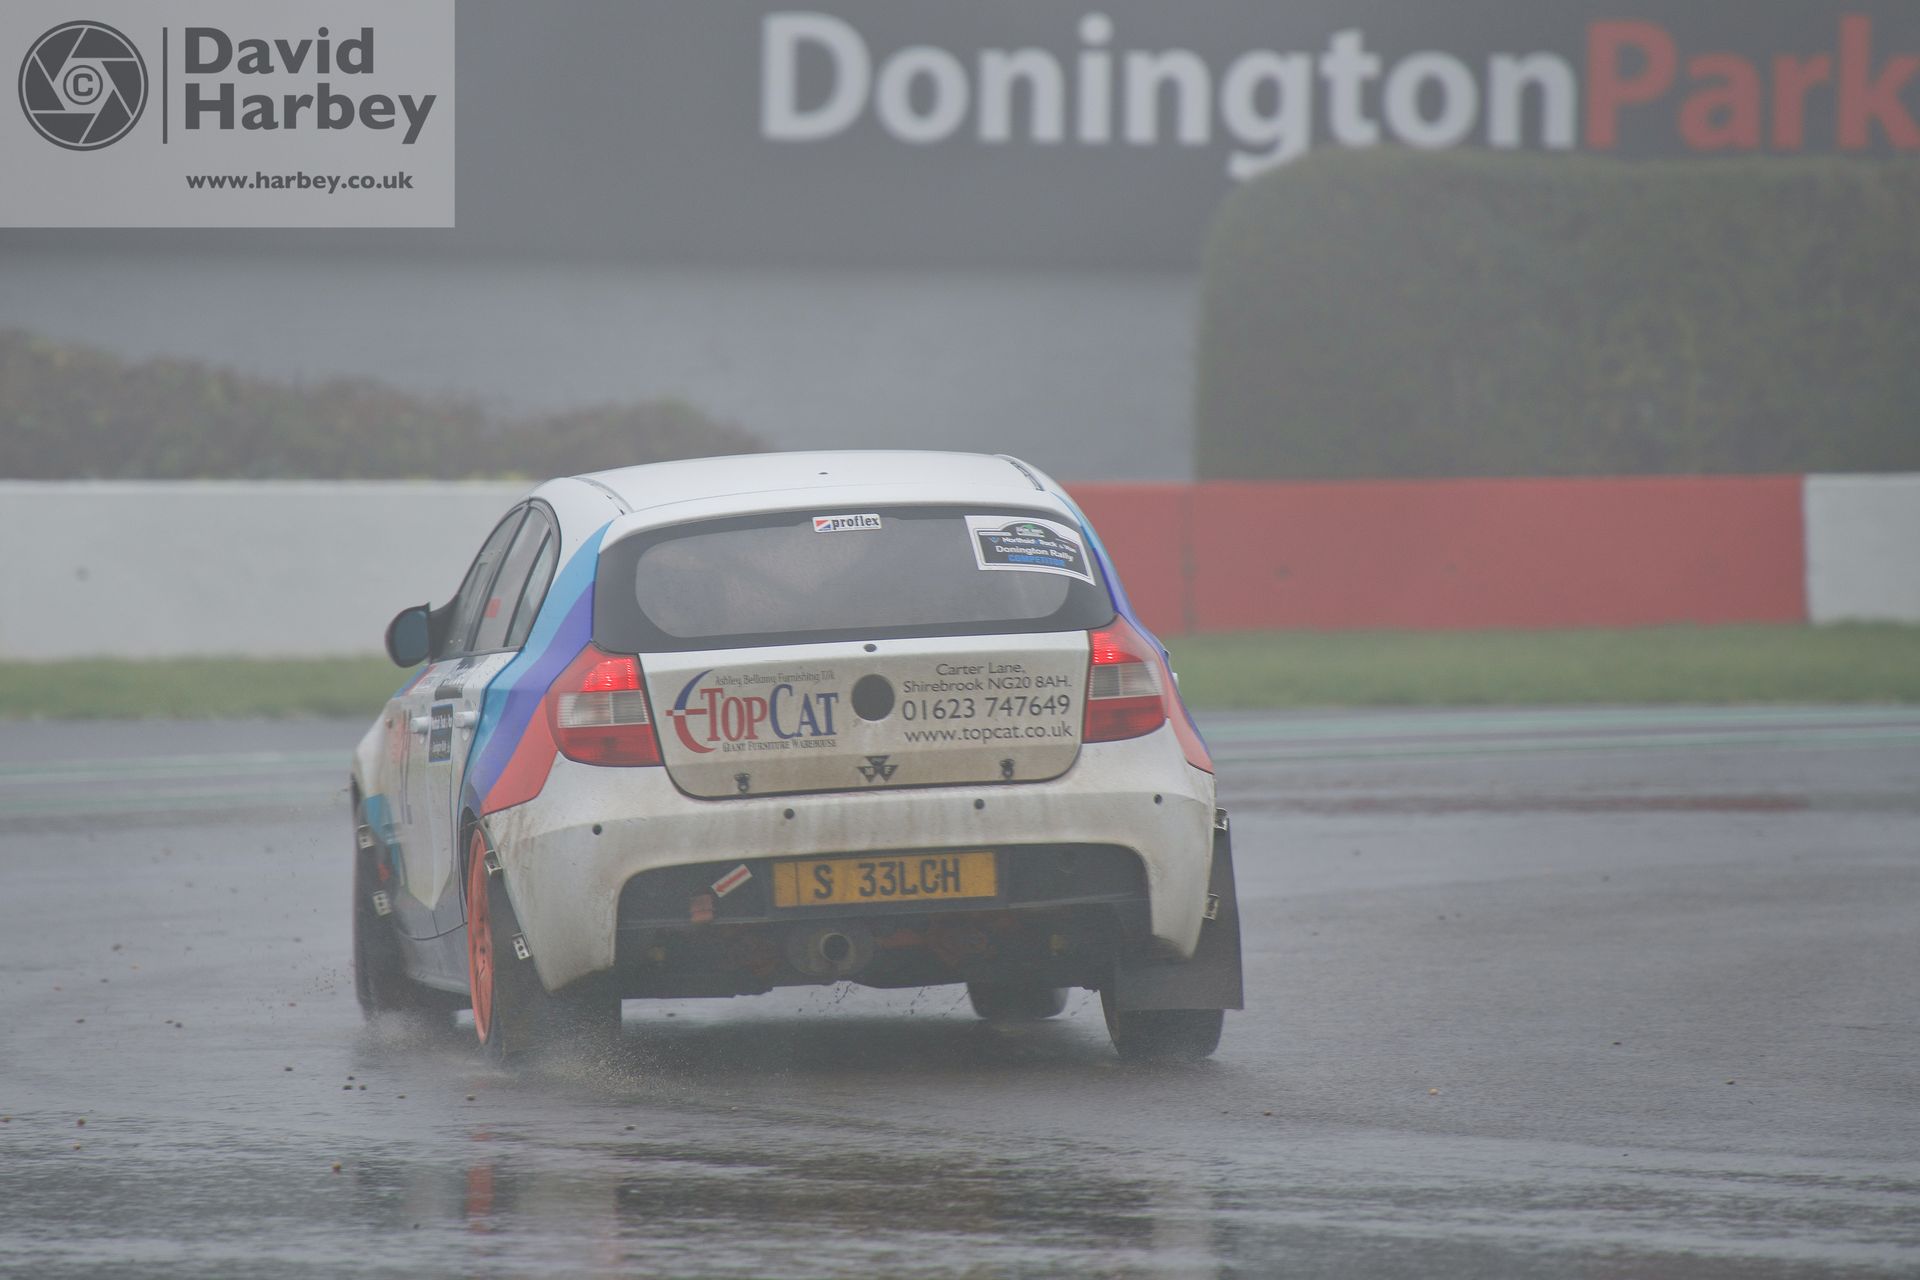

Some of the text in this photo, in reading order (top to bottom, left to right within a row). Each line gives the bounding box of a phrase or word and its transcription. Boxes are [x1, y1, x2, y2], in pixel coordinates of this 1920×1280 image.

[831, 515, 880, 531] proflex
[995, 545, 1050, 556] Donington
[1050, 549, 1074, 562] Rally
[936, 663, 984, 676] Carter
[903, 678, 984, 694] Shirebrook
[988, 676, 1031, 690] NG20
[902, 694, 1071, 721] 01623 747649
[904, 721, 1073, 744] www.topcat.co.uk
[813, 858, 961, 899] S 33LCH
